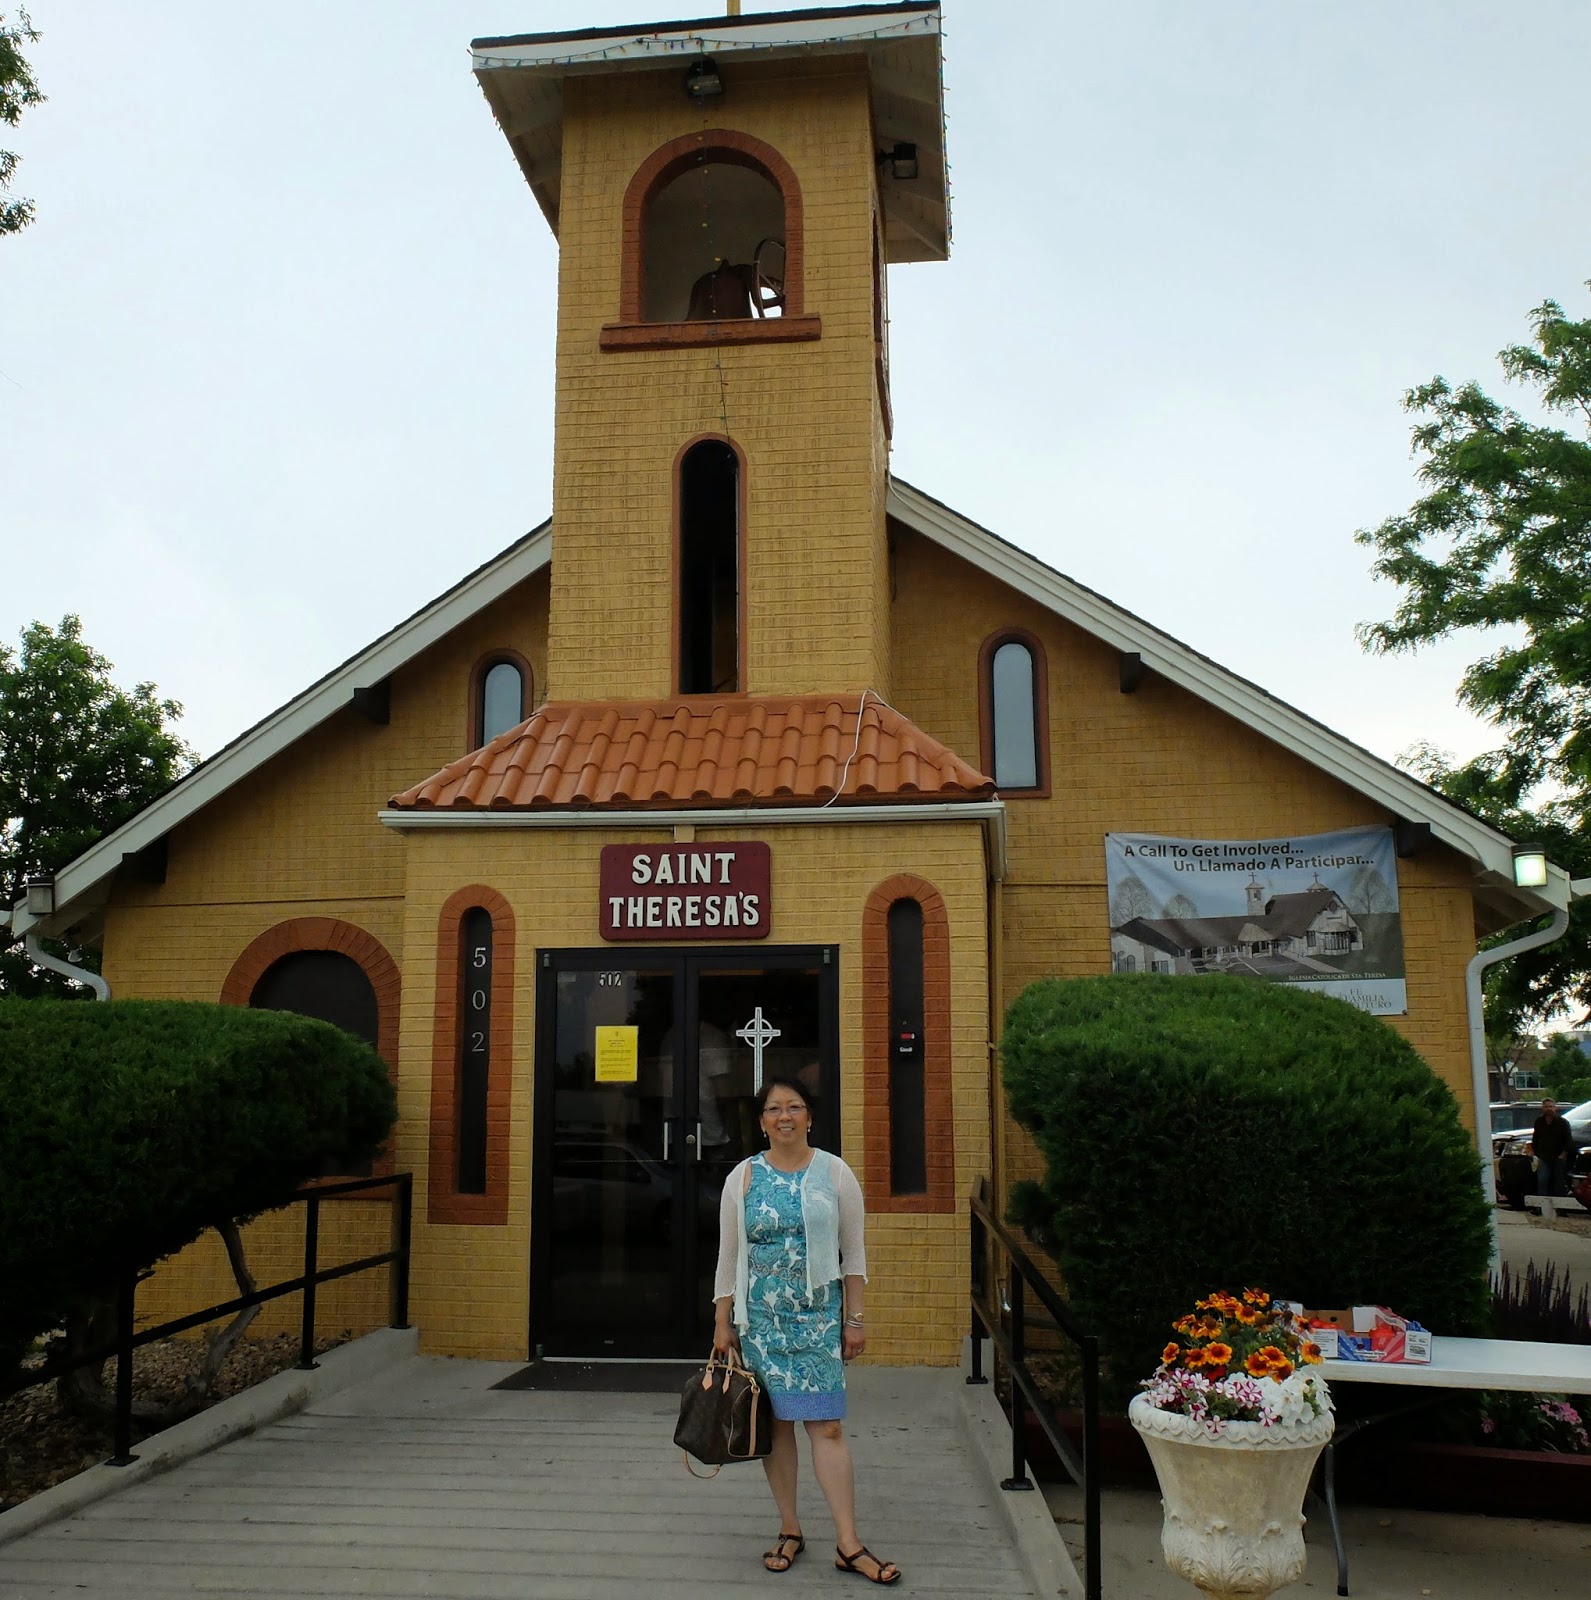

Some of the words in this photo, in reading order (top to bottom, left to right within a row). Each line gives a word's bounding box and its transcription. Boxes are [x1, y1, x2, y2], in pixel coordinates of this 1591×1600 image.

[1124, 844, 1135, 857] A
[1138, 844, 1167, 858] Call
[1169, 844, 1188, 858] To
[1191, 844, 1220, 858] Get
[1223, 841, 1304, 857] Involved...
[631, 852, 736, 885] SAINT
[1173, 860, 1195, 872] Un
[1199, 858, 1266, 872] Llamado
[1270, 857, 1281, 870] A
[1285, 854, 1374, 869] Participar...
[608, 891, 760, 928] THERESA'S
[598, 971, 622, 987] 502
[1350, 988, 1362, 996] FE
